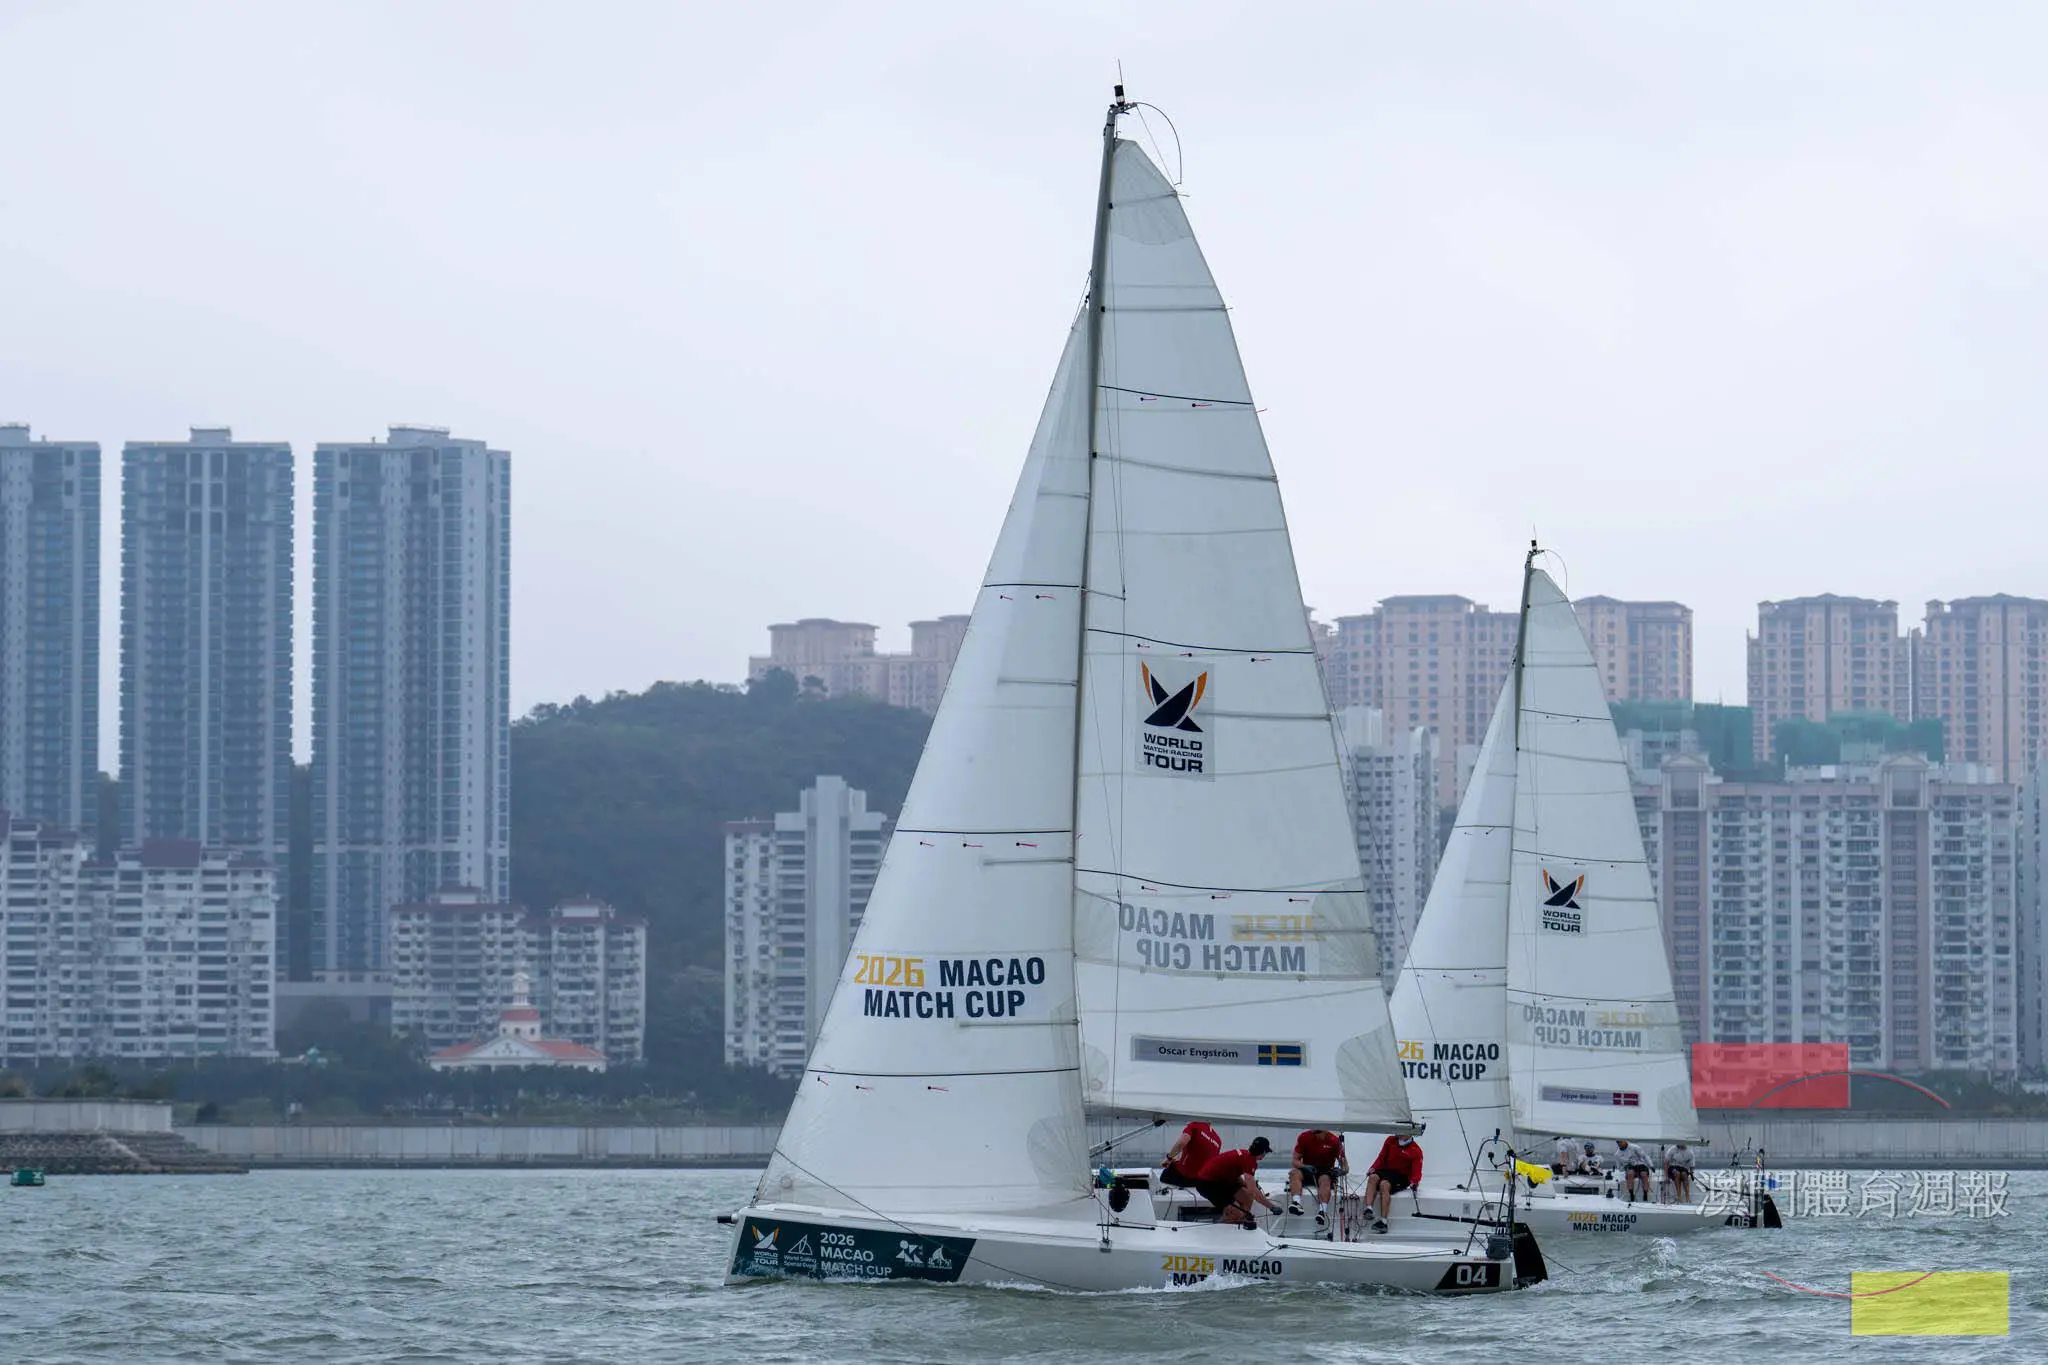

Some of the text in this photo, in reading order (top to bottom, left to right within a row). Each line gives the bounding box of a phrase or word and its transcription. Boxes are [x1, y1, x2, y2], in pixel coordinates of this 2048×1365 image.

[1143, 732, 1203, 751] WORLD
[1143, 744, 1203, 759] MATCH RACING
[1143, 751, 1203, 773] TOUR
[1543, 910, 1581, 921] WORLD
[1542, 920, 1581, 933] TOUR
[853, 955, 1046, 989] 2026 MACAO
[863, 988, 1026, 1019] MATCH CUP
[1158, 1045, 1239, 1060] Oscar Engström
[1397, 1040, 1500, 1061] 26 MACAO
[1400, 1061, 1487, 1080] ATCH CUP
[1567, 1210, 1637, 1224] 2026 MACAO
[1572, 1222, 1631, 1233] MATCH CUP
[820, 1231, 856, 1247] 2026
[753, 1250, 779, 1258] WORLD
[820, 1245, 875, 1263] MACAO
[753, 1258, 779, 1267] TOUR
[820, 1260, 865, 1276] MATCH
[866, 1264, 893, 1277] CUP
[1161, 1254, 1283, 1275] 2026 MACAO
[1172, 1272, 1208, 1287] MAT
[1456, 1264, 1488, 1286] 04
